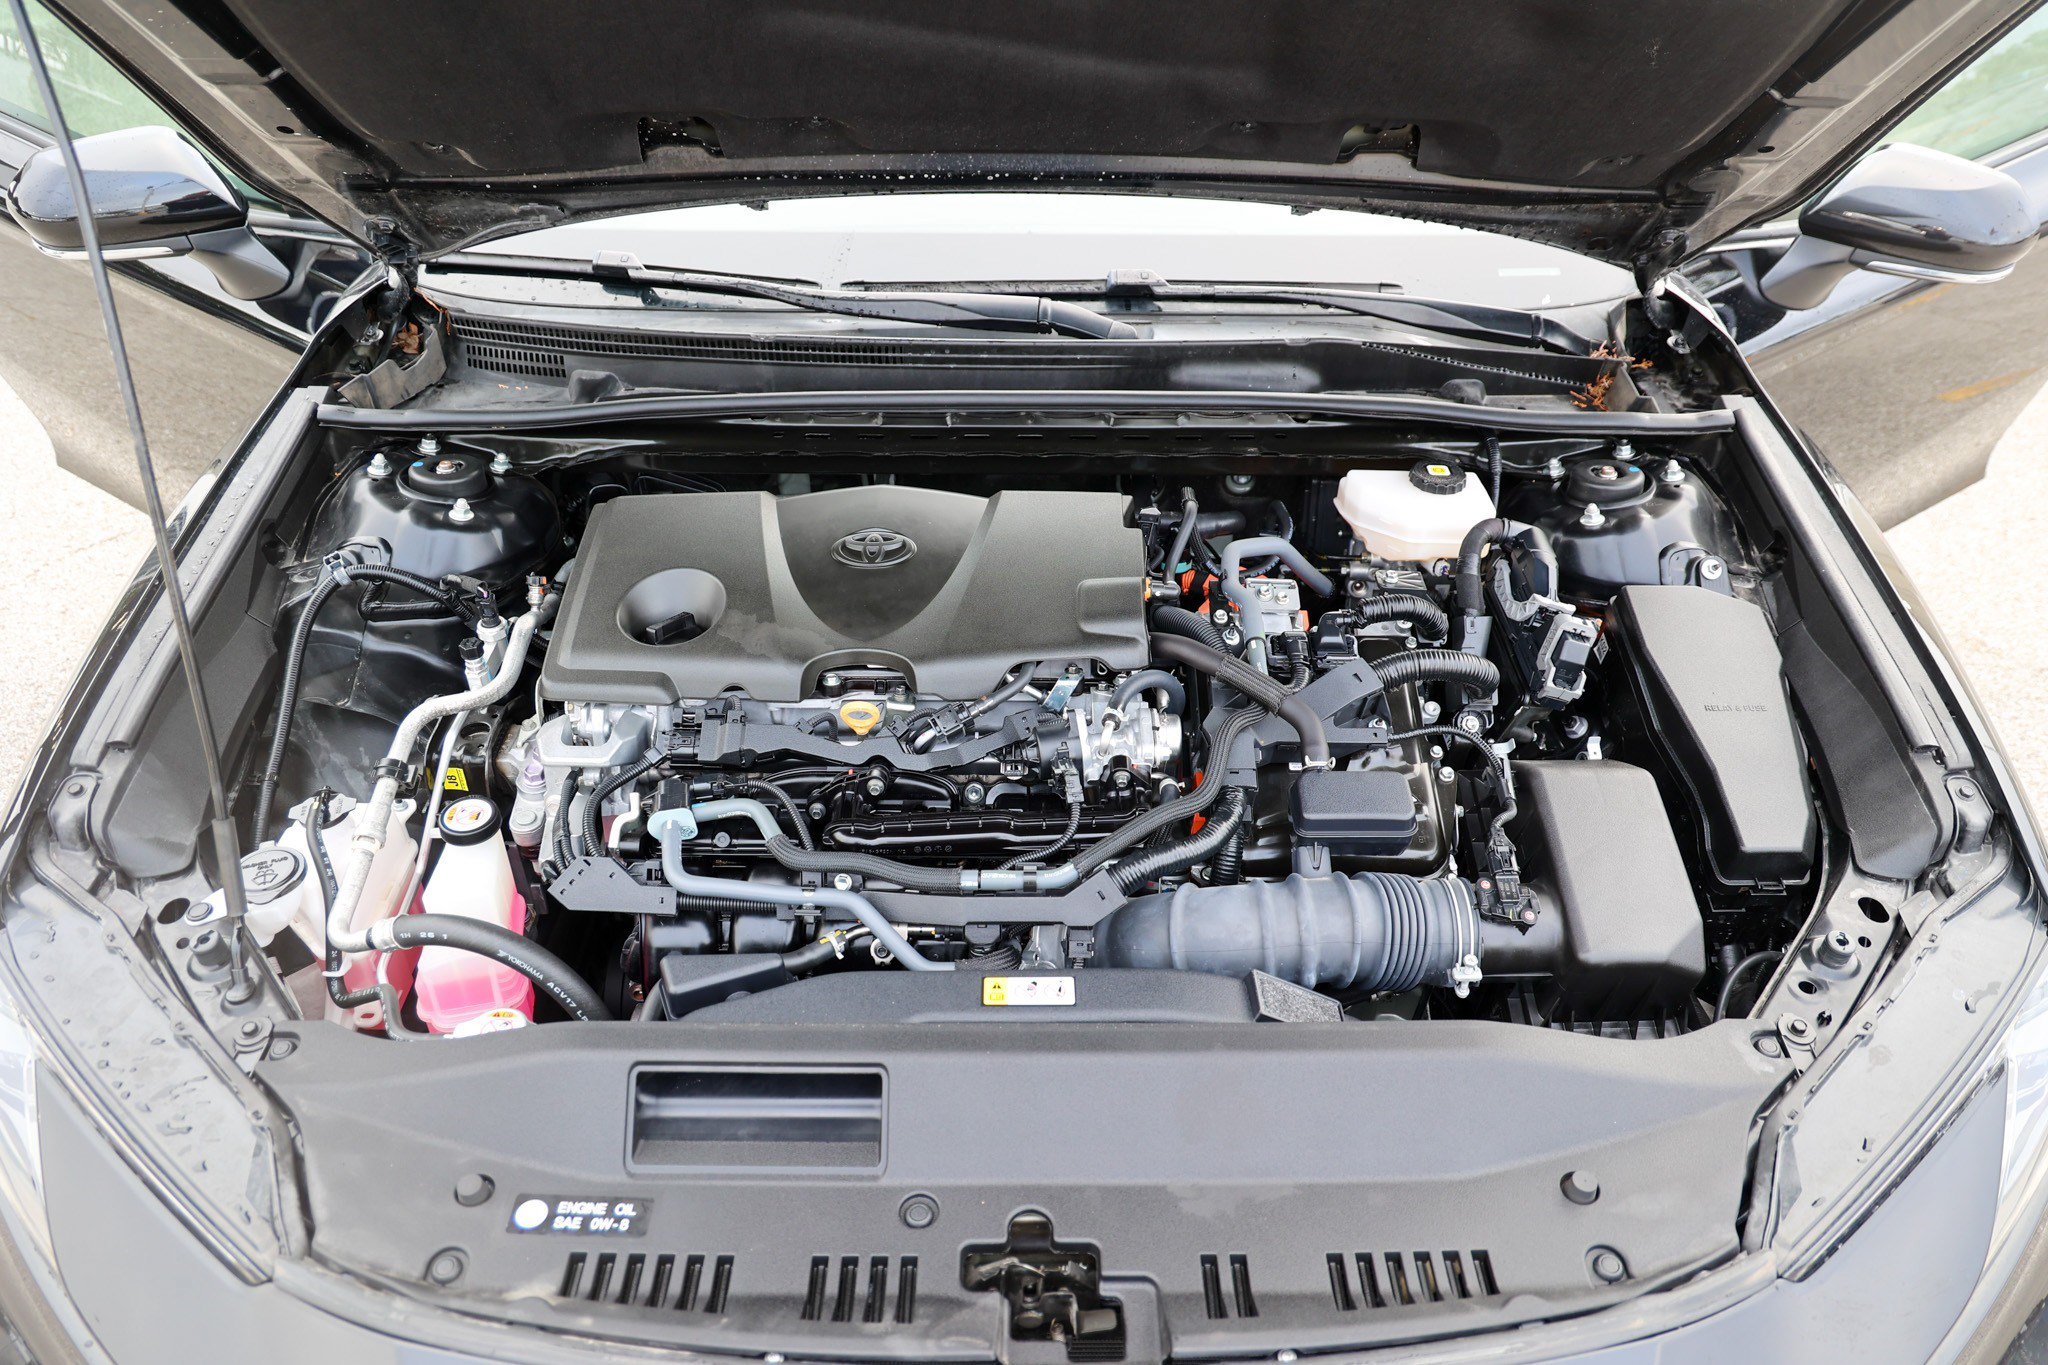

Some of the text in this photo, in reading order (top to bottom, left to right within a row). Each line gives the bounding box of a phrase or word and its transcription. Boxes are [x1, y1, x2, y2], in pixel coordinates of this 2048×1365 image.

[506, 954, 544, 981] YOKOHAMA
[546, 981, 578, 1008] ACV17
[556, 1201, 637, 1217] ENGINE OIL
[552, 1215, 583, 1231] SAE
